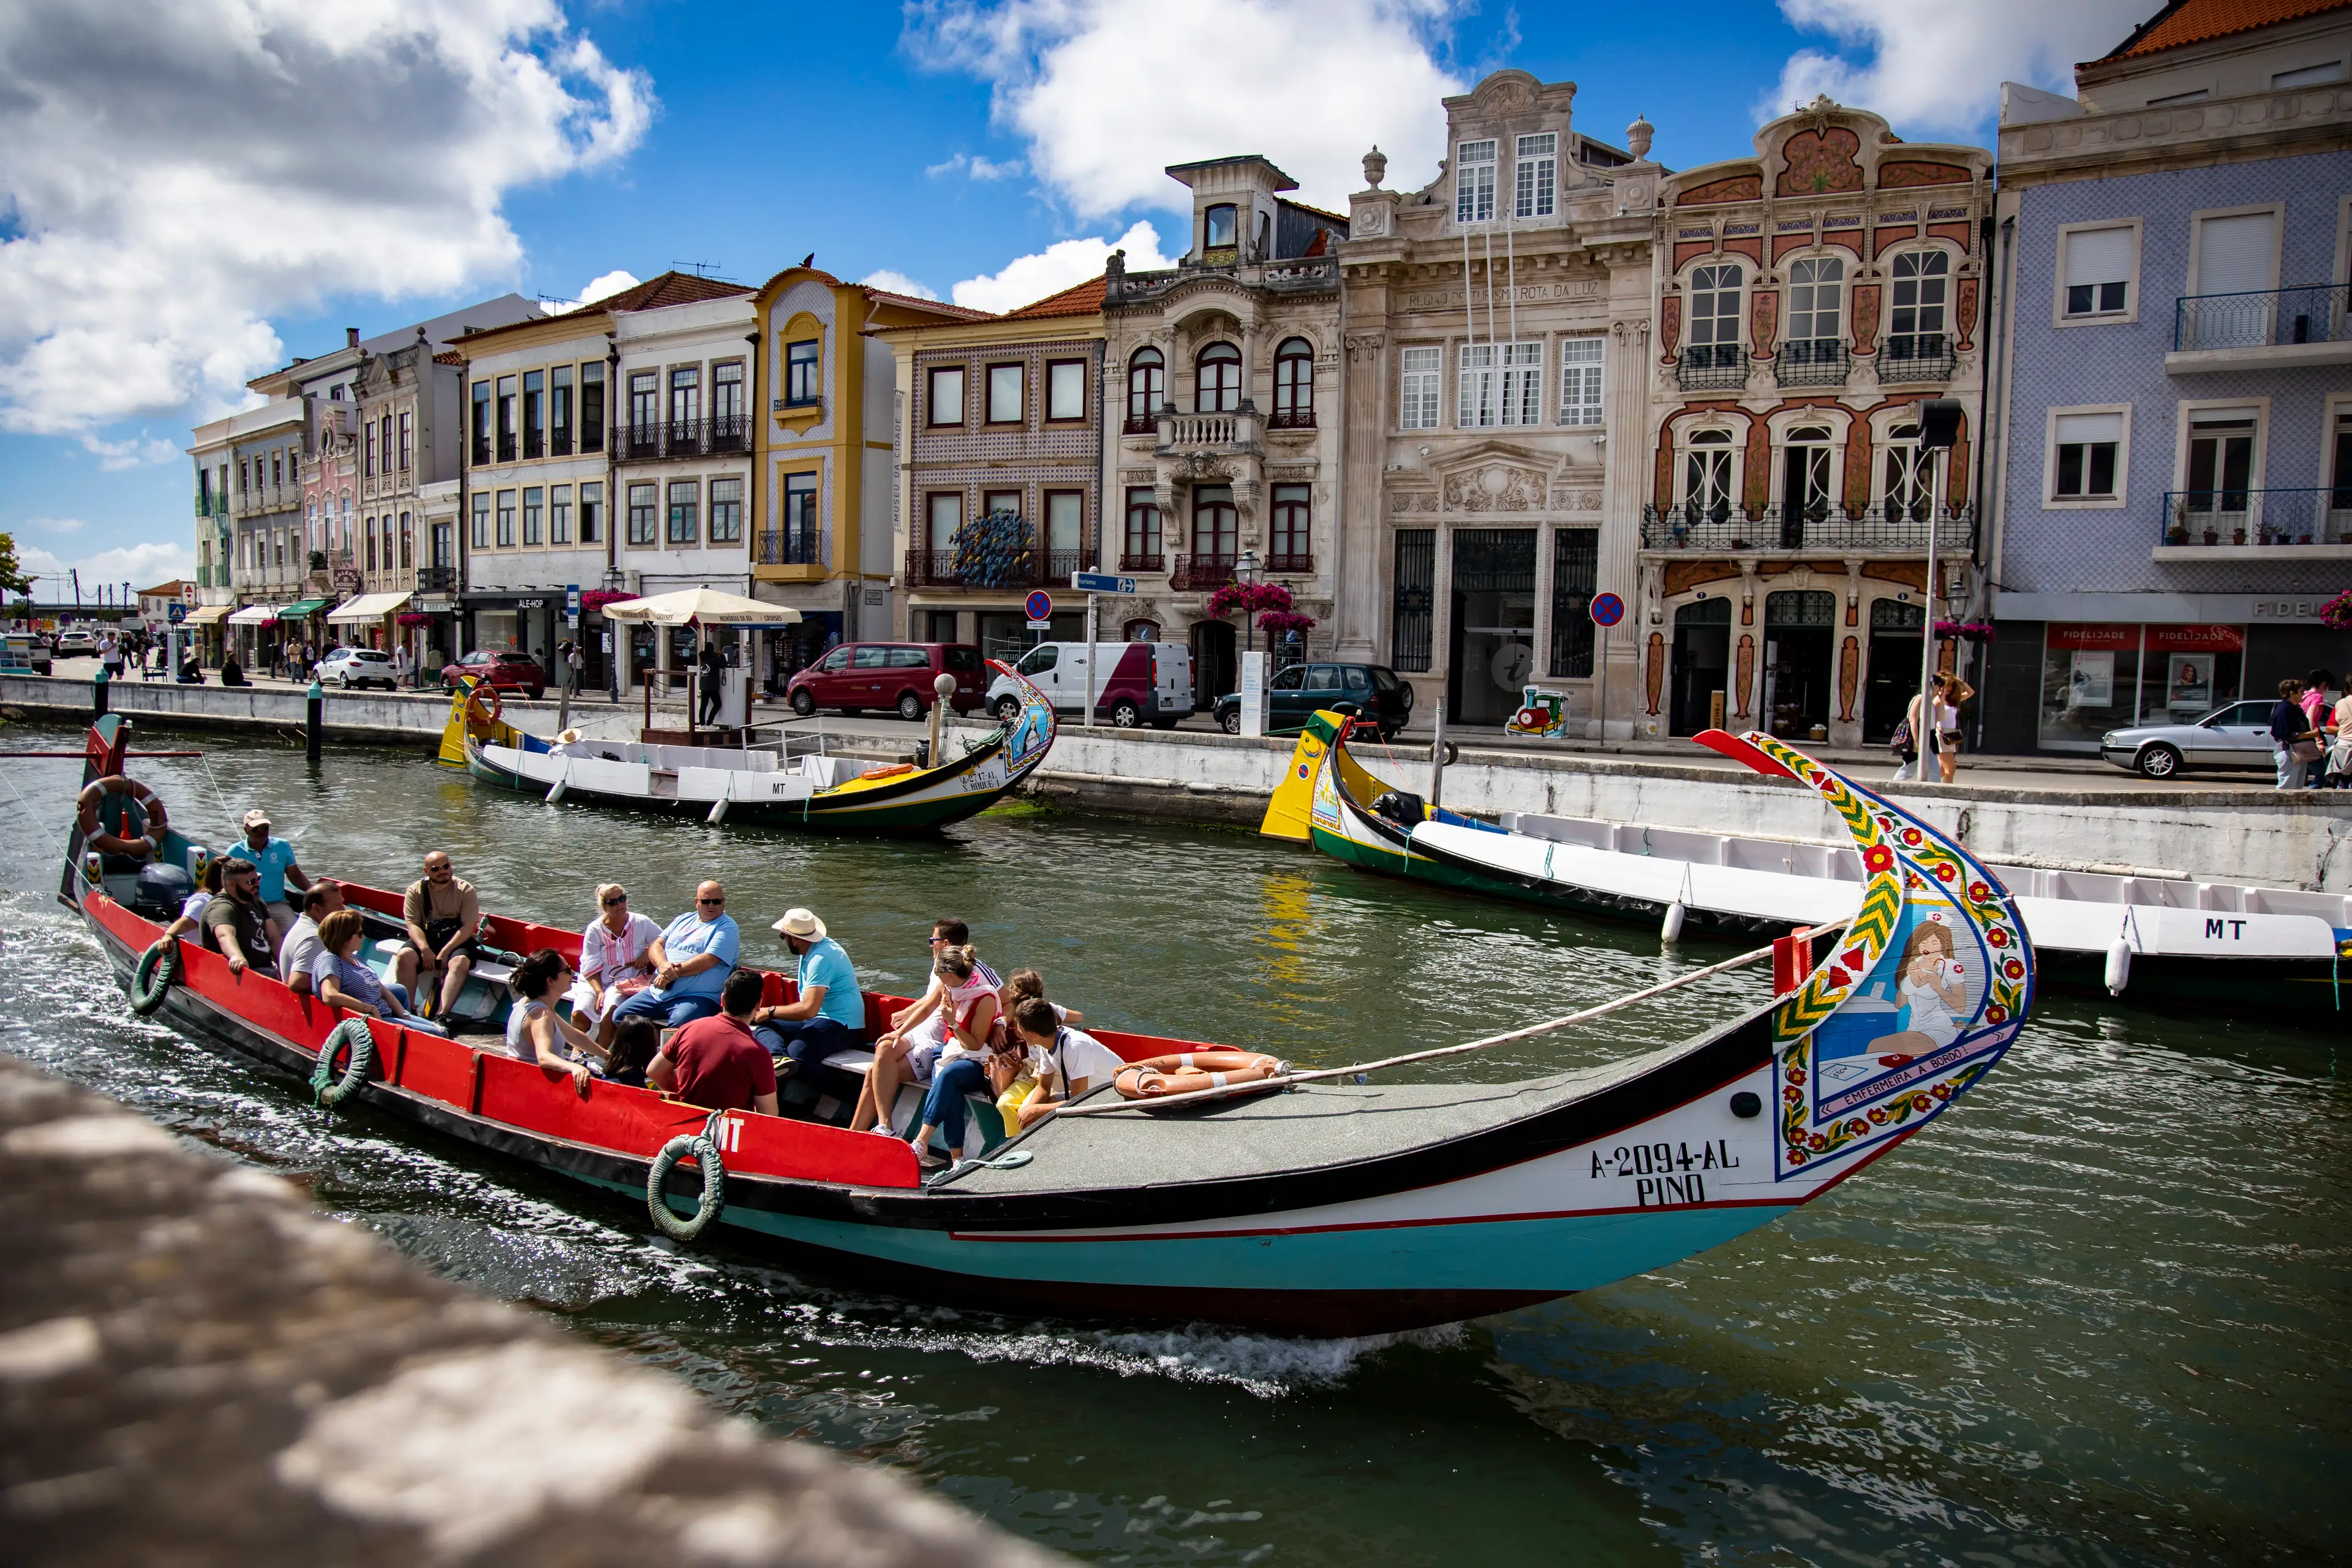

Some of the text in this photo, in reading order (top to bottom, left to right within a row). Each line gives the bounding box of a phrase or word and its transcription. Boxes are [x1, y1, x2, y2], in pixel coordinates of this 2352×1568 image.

[1520, 287, 1548, 300] ROTA
[1554, 285, 1569, 297] DA
[1574, 282, 1599, 296] LUZ
[894, 464, 900, 478] DA
[334, 570, 357, 582] GALERIA
[2159, 632, 2223, 641] FIDELIDADE
[963, 771, 997, 784] A-2717-AL
[772, 783, 786, 794] MT
[2205, 918, 2247, 940] MT
[1833, 1066, 1848, 1078] STCW
[1844, 1071, 1913, 1105] EMFERMEIRA
[1918, 1066, 1928, 1075] A
[714, 1117, 745, 1153] MT
[1591, 1139, 1740, 1178] A-2094-AL
[1636, 1174, 1705, 1206] PINO
